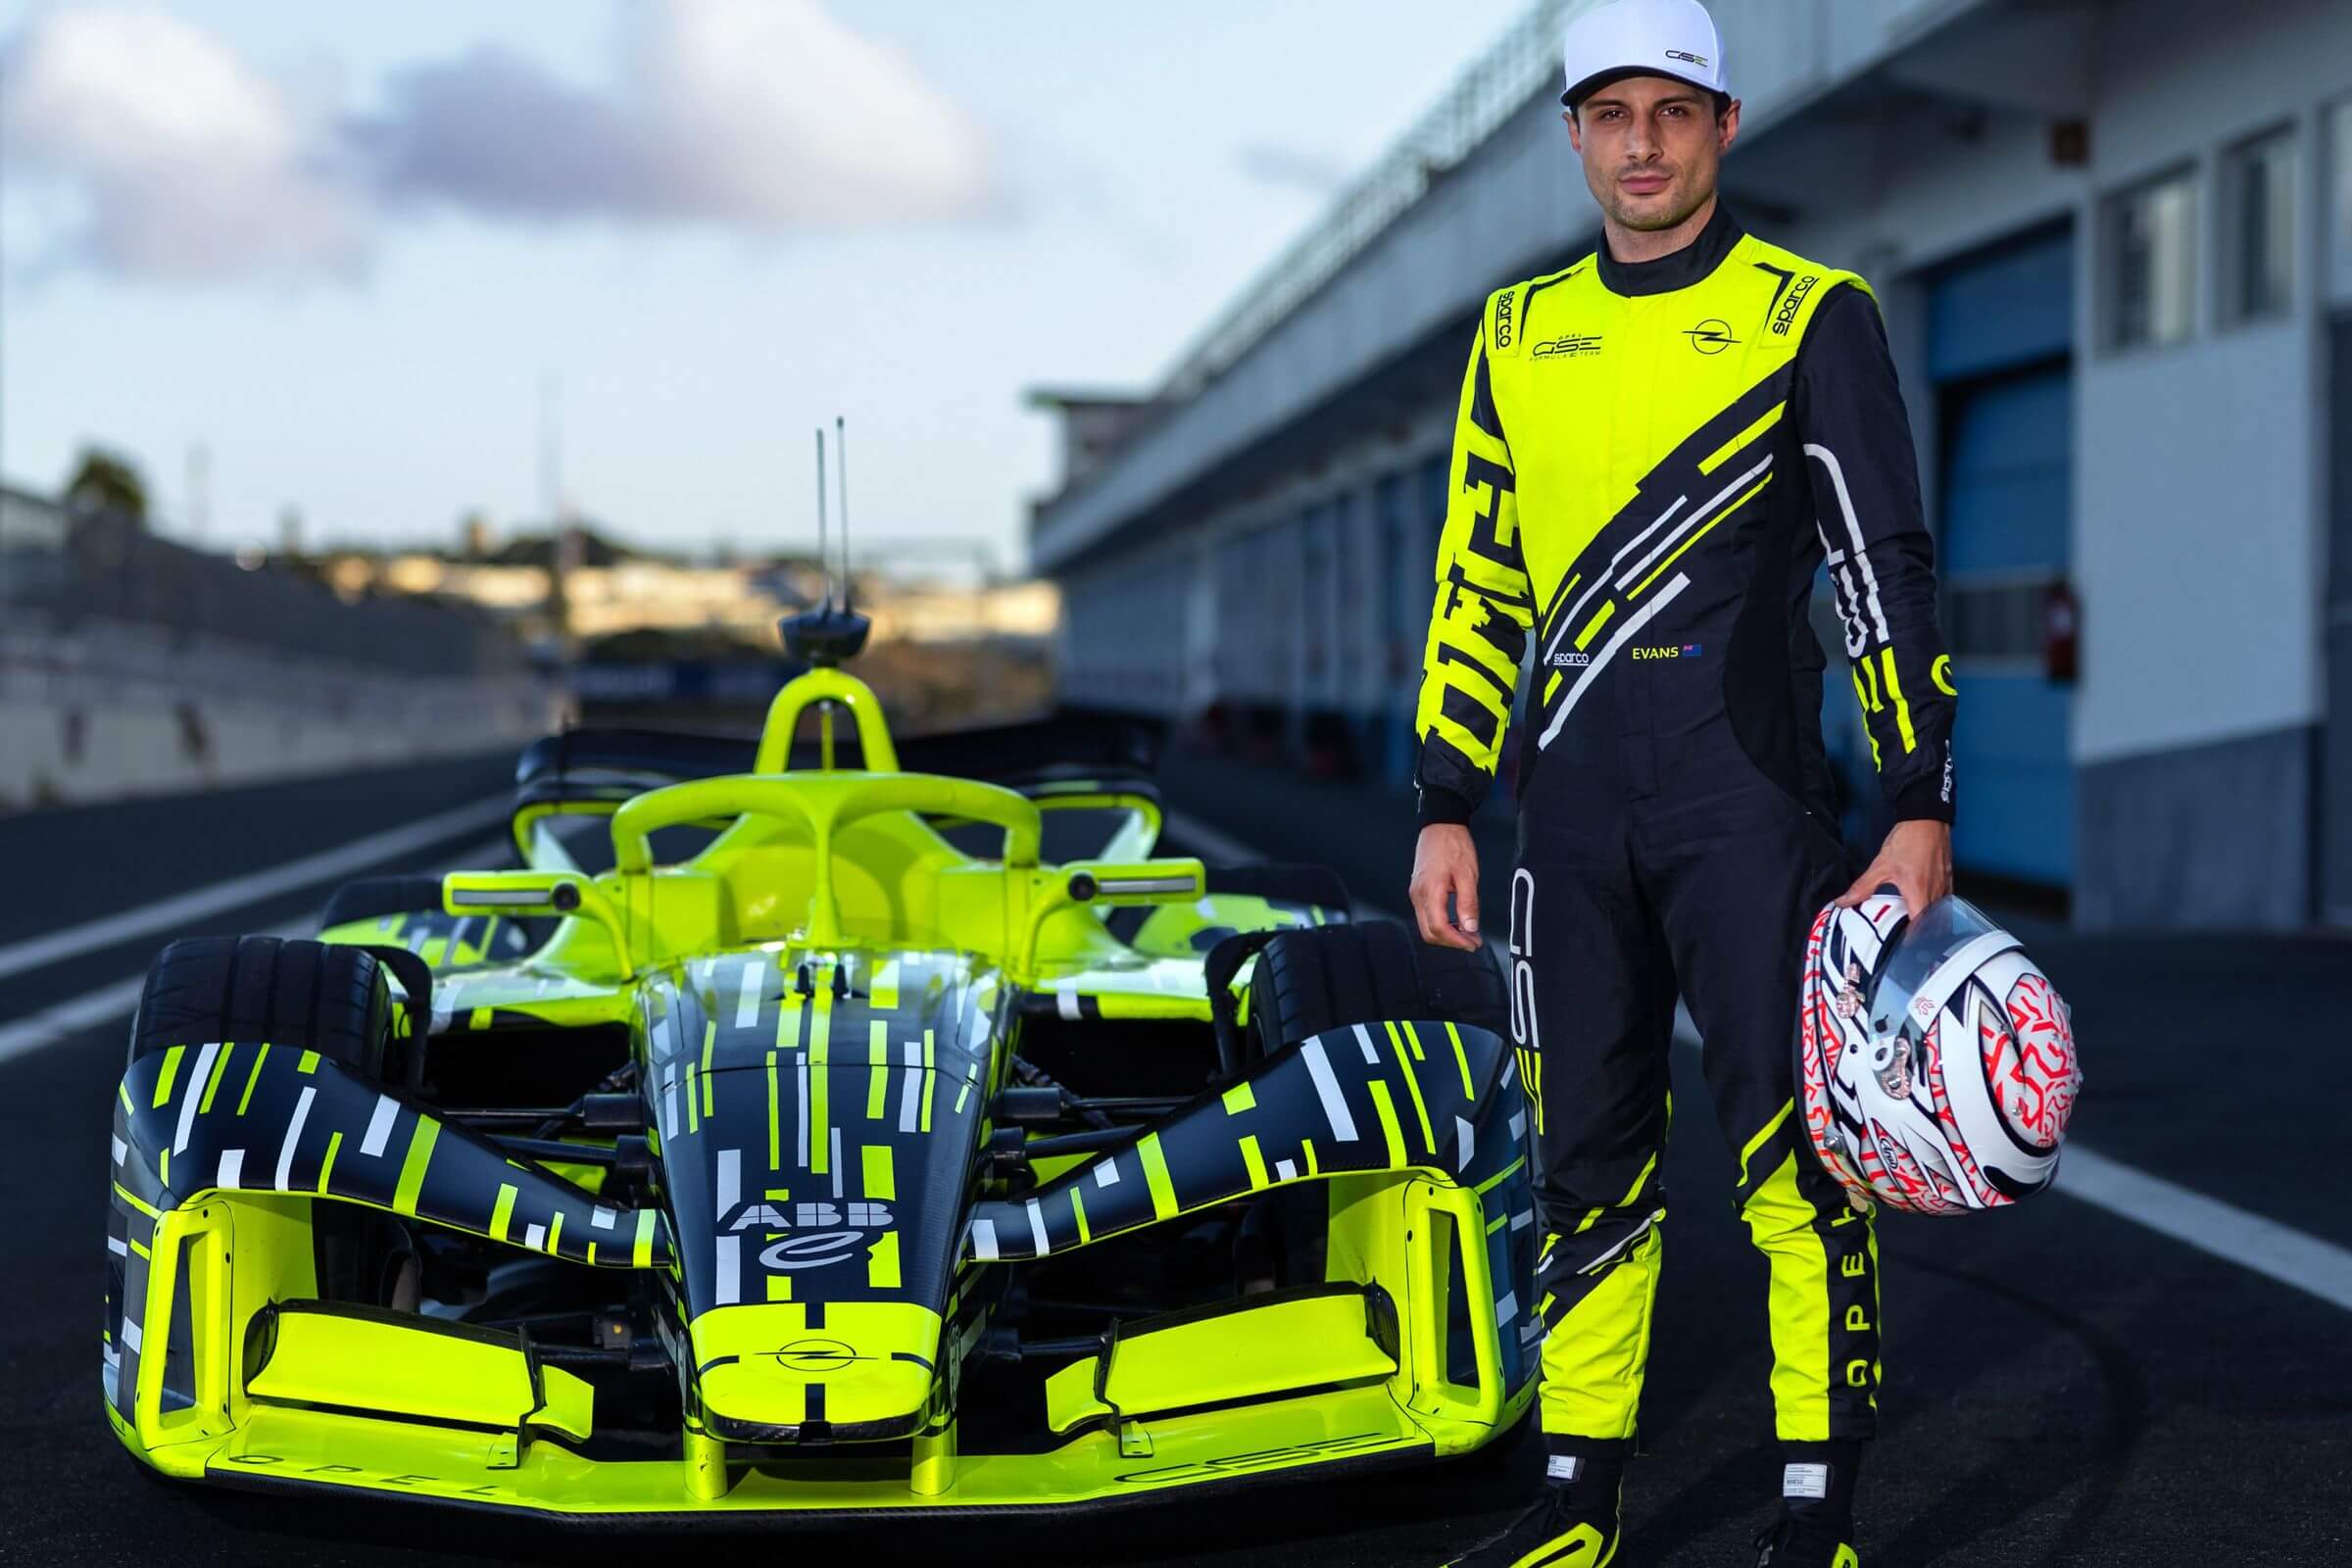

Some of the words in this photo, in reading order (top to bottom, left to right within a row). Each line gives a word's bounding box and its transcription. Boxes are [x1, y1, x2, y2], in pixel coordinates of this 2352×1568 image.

[1495, 291, 1515, 349] sparco
[1772, 275, 1820, 336] sparco
[1553, 653, 1589, 665] sparco
[1632, 647, 1679, 660] EVANS
[729, 1202, 894, 1230] ABB
[1831, 1206, 1871, 1387] OPEL
[228, 1454, 500, 1495] OPEL
